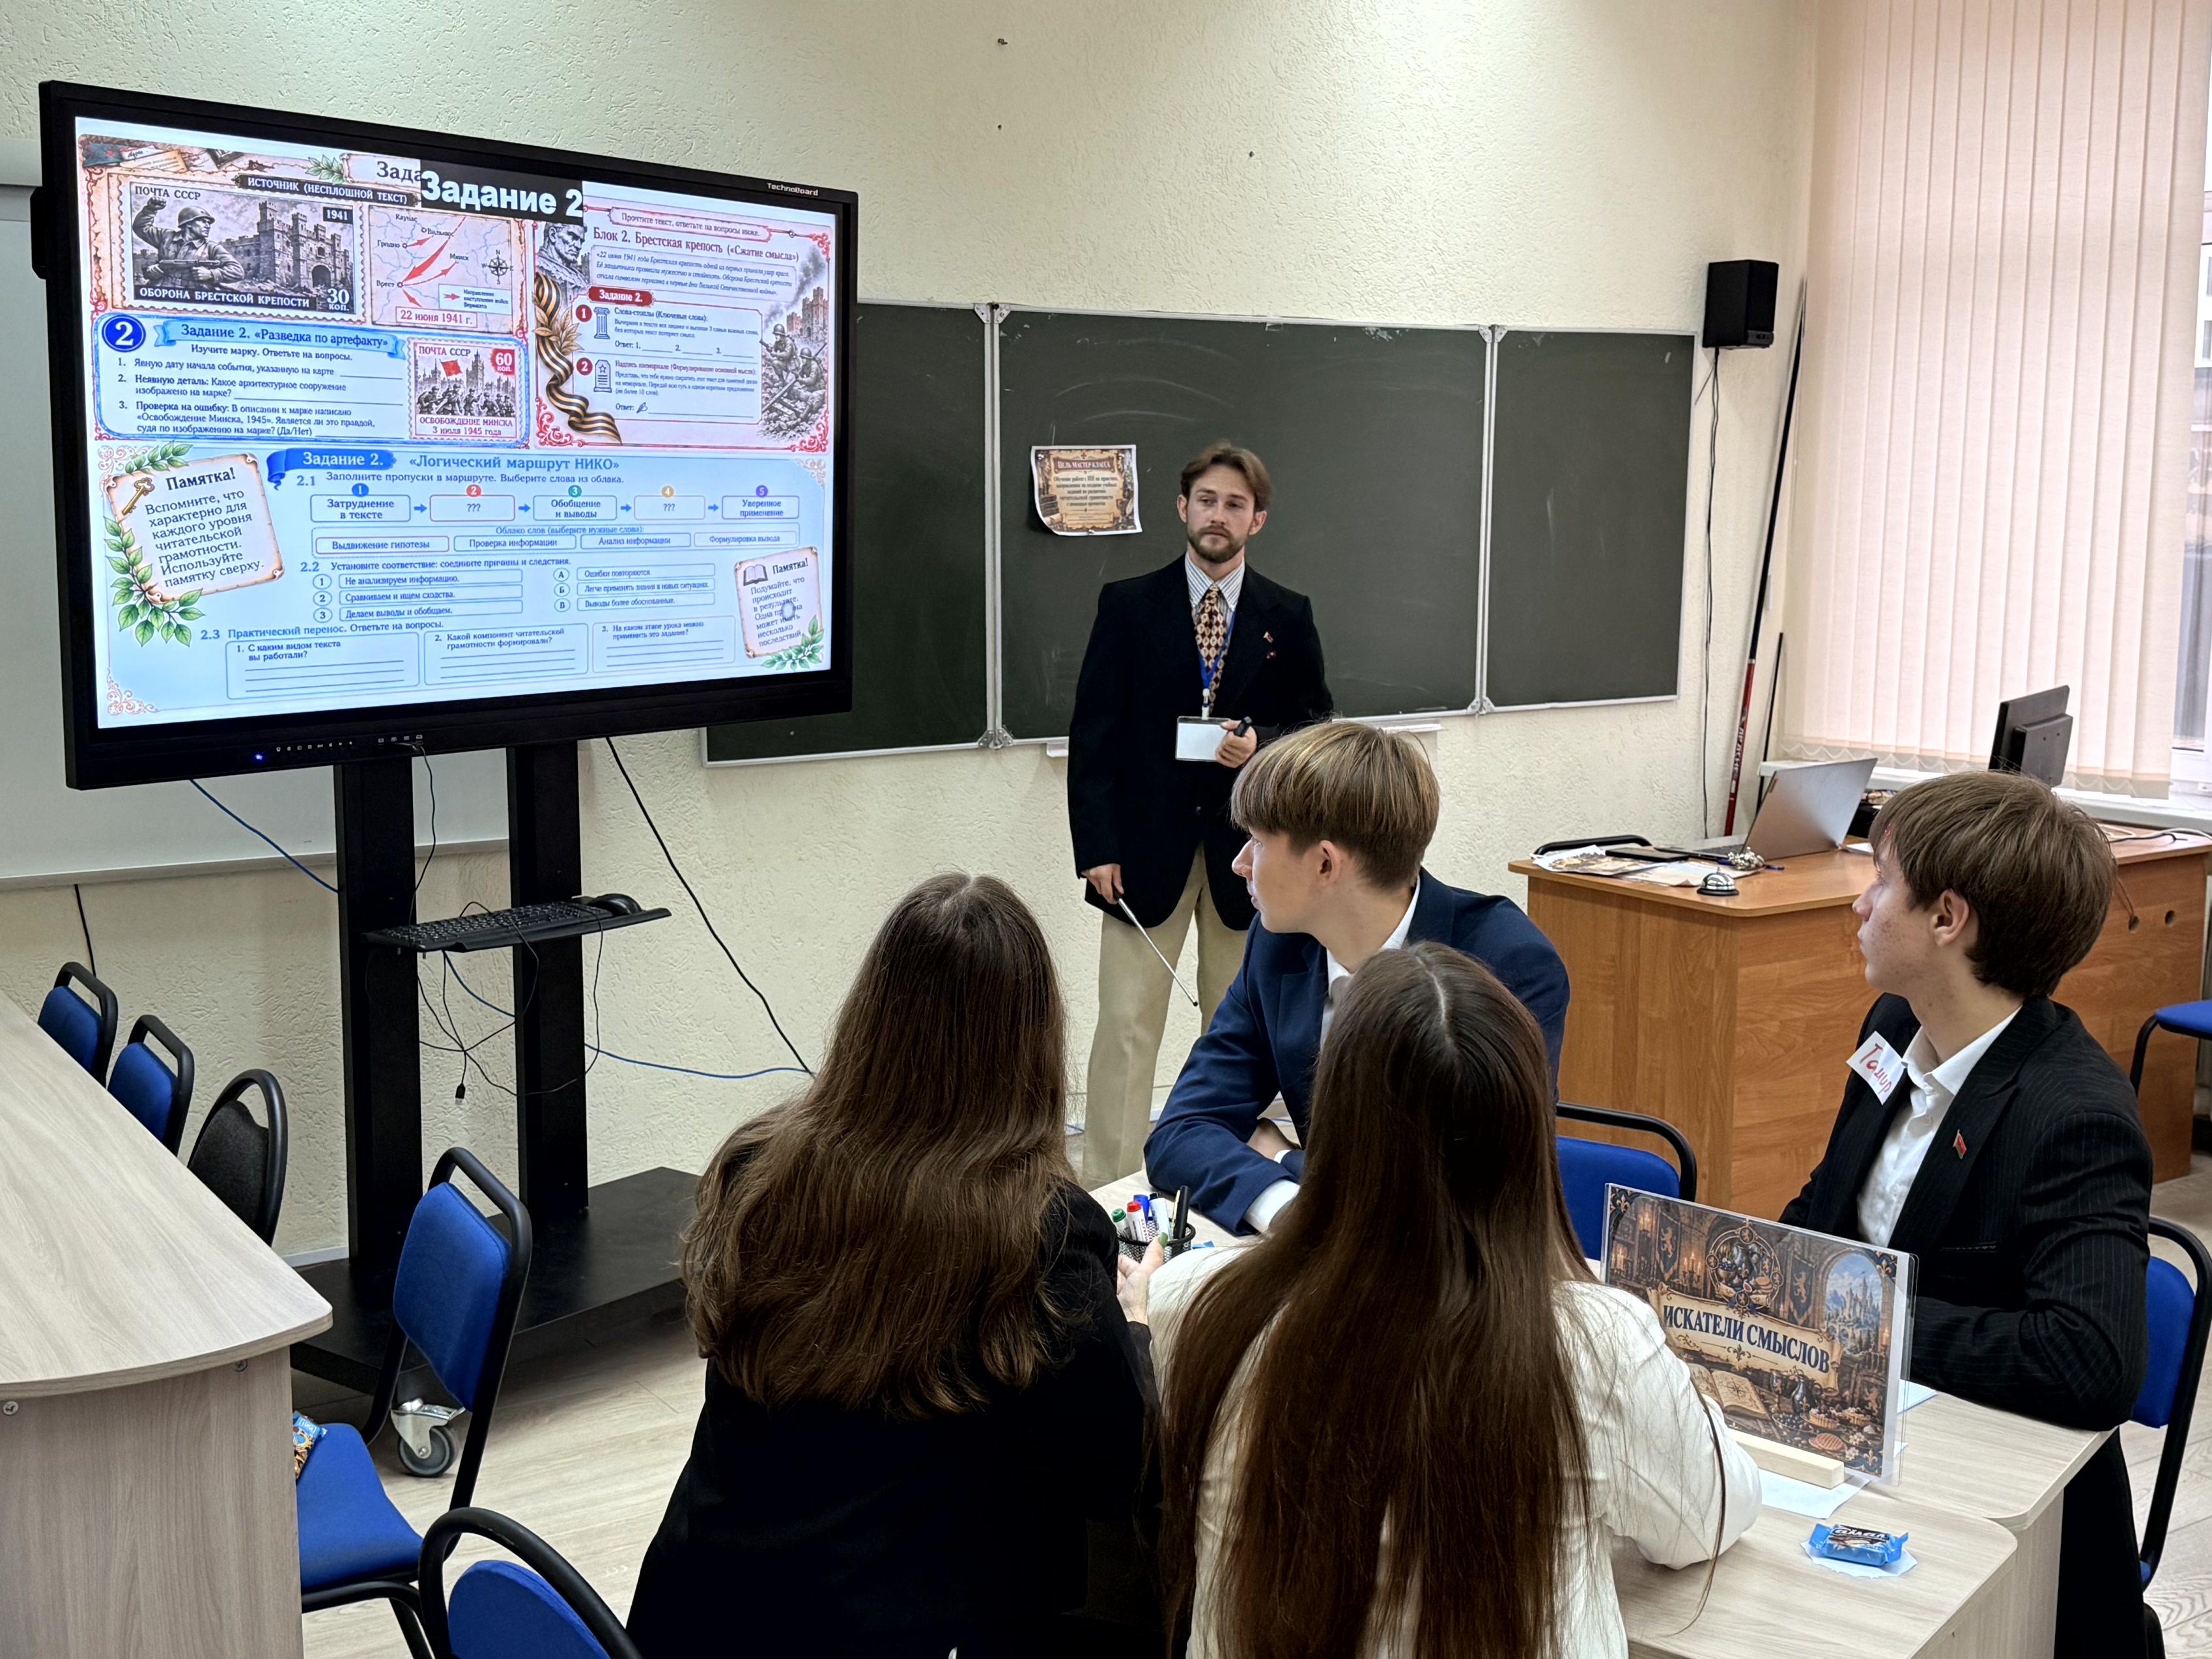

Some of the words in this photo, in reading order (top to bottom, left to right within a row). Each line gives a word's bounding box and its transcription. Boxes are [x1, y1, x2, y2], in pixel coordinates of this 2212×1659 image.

[135, 186, 169, 197] ПОЧТА
[175, 190, 201, 200] СССР
[248, 178, 299, 191] ИСТОЧНИК
[304, 184, 373, 199] (НЕСПЛОШНОЙ
[377, 192, 408, 205] ТЕКСТ)
[421, 170, 557, 215] Задание
[565, 189, 583, 218] 2
[767, 182, 818, 196] TechnoBoard
[326, 210, 348, 220] 1941
[655, 218, 674, 227] текст,
[675, 221, 702, 230] ответьте
[593, 227, 617, 242] Блок
[621, 231, 631, 244] 2.
[636, 232, 682, 248] Брестская
[686, 240, 722, 253] крепость
[728, 244, 763, 257] («Сжатие
[765, 251, 799, 261] смысла»)
[140, 287, 190, 300] ОБОРОНА
[195, 291, 253, 304] БРЕСТСКОЙ
[258, 296, 309, 307] КРЕПОСТИ
[327, 289, 350, 304] 30
[599, 290, 632, 302] Задание
[635, 293, 642, 302] 2.
[401, 310, 416, 320] 22
[416, 313, 438, 322] июня
[442, 313, 463, 323] 1941
[581, 309, 586, 318] 1
[115, 321, 134, 346] 2
[182, 324, 234, 338] Задание
[239, 327, 250, 339] 2.
[255, 329, 311, 343] «Разведка
[315, 335, 328, 345] по
[331, 335, 388, 348] артефакту»
[191, 345, 228, 355] Изучите
[231, 348, 259, 357] марку.
[262, 348, 300, 358] Ответьте
[315, 351, 352, 362] вопросы.
[419, 345, 446, 356] ПОЧТА
[449, 347, 470, 358] СССР
[495, 352, 513, 367] 60
[119, 358, 126, 366] 1.
[134, 358, 162, 369] Явную
[165, 362, 184, 370] дату
[313, 367, 334, 377] карте
[582, 362, 588, 371] 2
[119, 374, 126, 382] 2.
[135, 375, 174, 385] Неявную
[177, 377, 208, 387] деталь:
[212, 378, 236, 387] Какое
[238, 380, 297, 391] архитектурное
[300, 382, 346, 392] сооружение
[136, 387, 188, 397] изображено
[203, 389, 231, 398] марке?
[119, 401, 127, 409] 3.
[136, 402, 178, 413] Проверка
[289, 406, 312, 416] марке
[209, 414, 244, 425] Минска,
[247, 416, 273, 424] 1945».
[276, 416, 311, 426] Является
[419, 416, 480, 426] ОСВОБОЖДЕНИЕ
[483, 418, 513, 427] МИНСКА
[137, 425, 157, 434] судя
[160, 425, 170, 434] по
[173, 425, 231, 436] изображению
[247, 427, 274, 436] марке?
[277, 427, 312, 436] (Да/Нет)
[464, 427, 482, 436] 1945
[303, 452, 365, 466] Задание
[371, 453, 384, 466] 2.
[410, 455, 501, 468] «Логический
[507, 459, 571, 472] маршрут
[575, 458, 619, 470] НИКО»
[165, 467, 236, 491] Памятка!
[297, 475, 315, 486] 2.1
[326, 472, 382, 482] Заполните
[386, 473, 433, 484] пропуски
[550, 474, 575, 483] слова
[358, 486, 363, 495] 1
[470, 487, 477, 495] 2
[572, 487, 578, 496] 3
[664, 487, 671, 496] 4
[759, 487, 765, 496] 5
[145, 494, 220, 515] Вспомните,
[223, 490, 244, 500] что
[327, 499, 394, 510] Затруднение
[551, 499, 601, 509] Обобщение
[742, 499, 781, 509] Уверенное
[149, 506, 223, 528] характерно
[226, 502, 248, 514] для
[348, 511, 382, 519] тексте
[563, 509, 597, 519] выводы
[152, 522, 206, 541] каждого
[209, 513, 253, 531] уровня
[496, 526, 525, 535] Облако
[155, 526, 242, 551] читательской
[332, 540, 388, 550] Выдвижение
[391, 540, 429, 550] гипотезы
[470, 539, 507, 548] Проверка
[509, 538, 557, 548] информации
[709, 534, 756, 545] Формулировка
[158, 543, 242, 563] грамотности.
[162, 552, 244, 576] Используйте
[300, 562, 320, 572] 2.2
[331, 562, 379, 571] Установите
[773, 558, 808, 574] Памятка!
[165, 569, 216, 588] памятку
[220, 561, 264, 577] сверху.
[345, 576, 356, 585] Не
[755, 612, 773, 620] Одна
[201, 629, 220, 640] 2.3
[228, 627, 300, 639] Практический
[304, 625, 347, 637] перенос.
[350, 623, 390, 633] Ответьте
[758, 625, 793, 638] несколько
[248, 644, 255, 652] С
[257, 643, 284, 651] каким
[315, 640, 341, 649] текста
[447, 641, 495, 650] грамотности
[498, 636, 552, 649] формировали?
[263, 651, 307, 662] работали?
[1663, 1304, 1744, 1342] ИСКАТЕЛИ
[1747, 1324, 1830, 1374] СМЫСЛОВ
